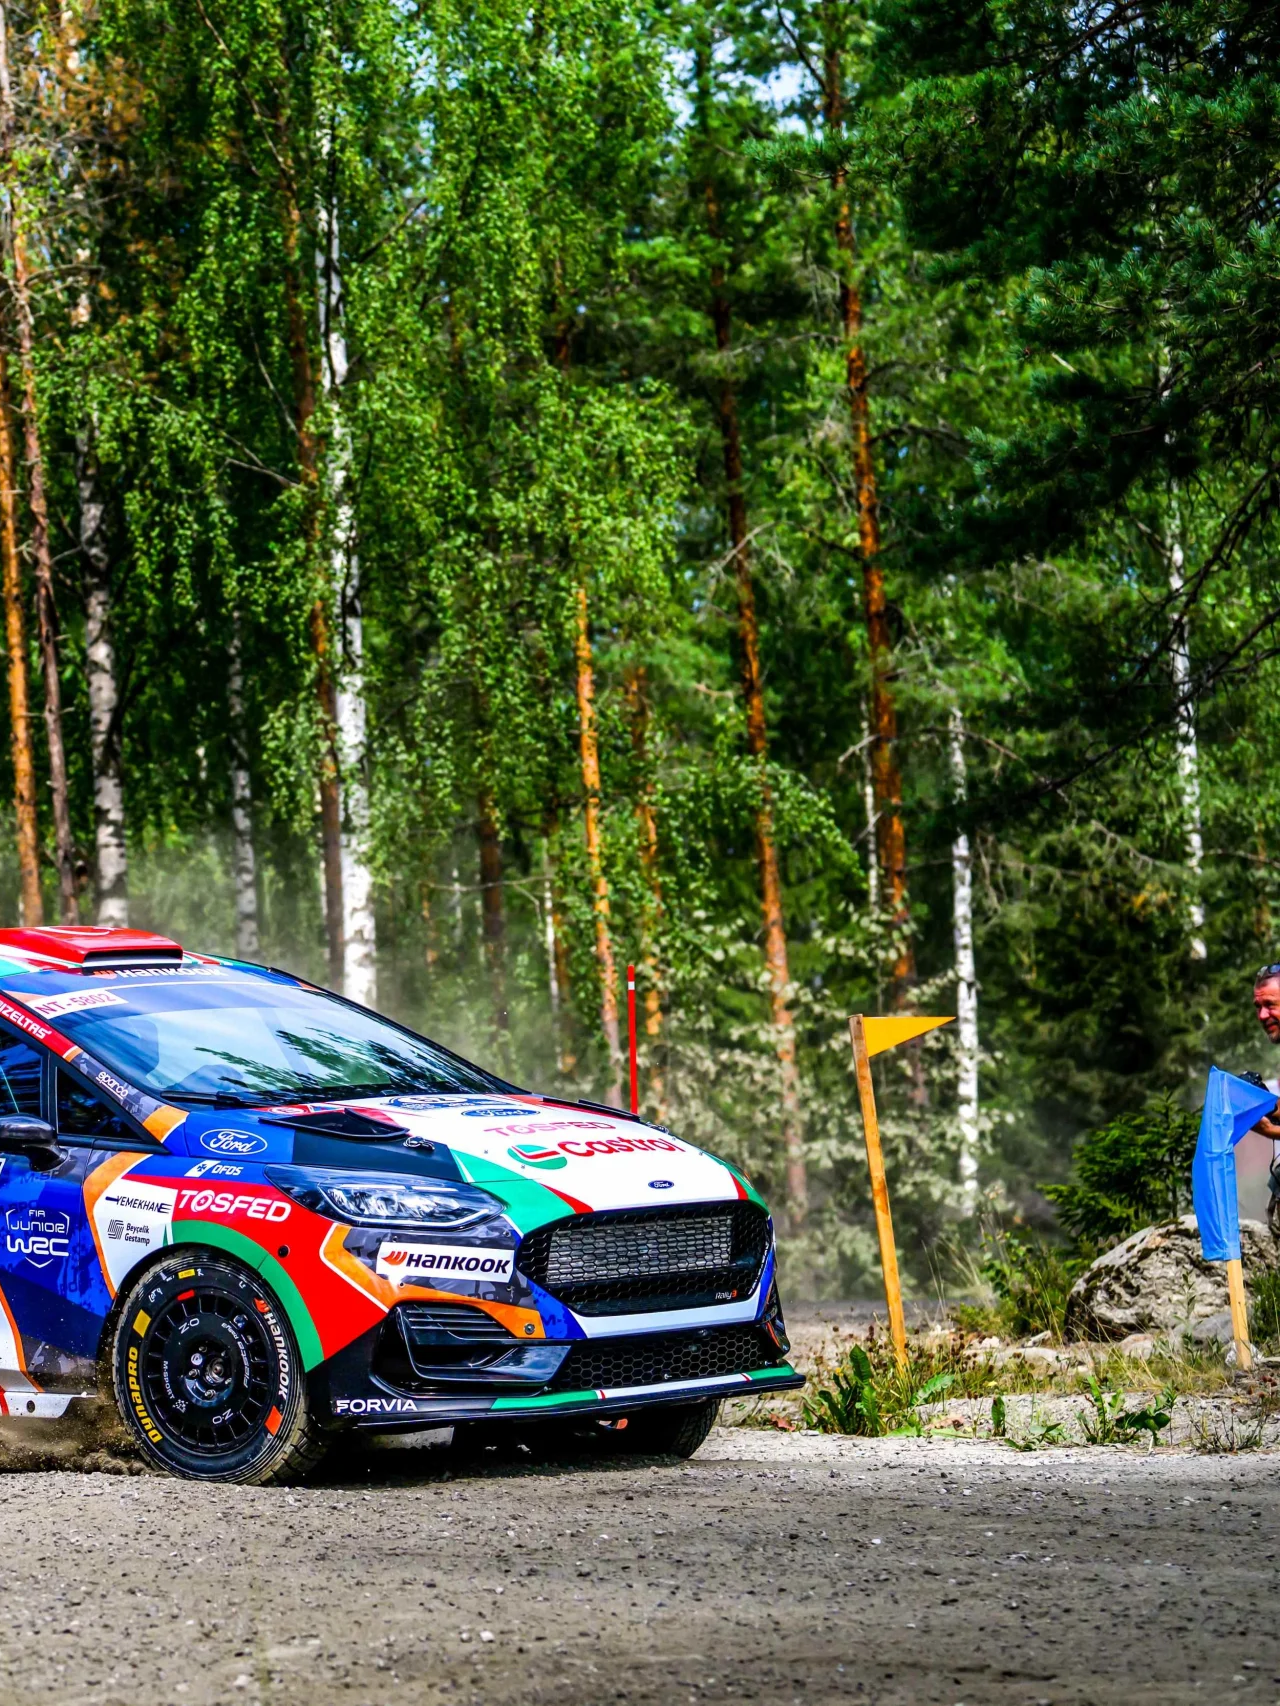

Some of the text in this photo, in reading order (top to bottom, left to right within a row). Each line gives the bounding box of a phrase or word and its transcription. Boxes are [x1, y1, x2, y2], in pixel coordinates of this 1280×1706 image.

[484, 1121, 617, 1137] TOSFED
[209, 1130, 258, 1153] Ford
[557, 1135, 687, 1158] Castrol
[116, 1195, 173, 1215] YEMEKHANE
[178, 1189, 292, 1222] TOSFED
[28, 1209, 46, 1218] FIA
[10, 1221, 65, 1234] JUNIOR
[125, 1223, 150, 1235] Beyçelik
[6, 1235, 70, 1257] WRC
[124, 1233, 151, 1247] Gestamp
[335, 1398, 419, 1413] FORVIA
